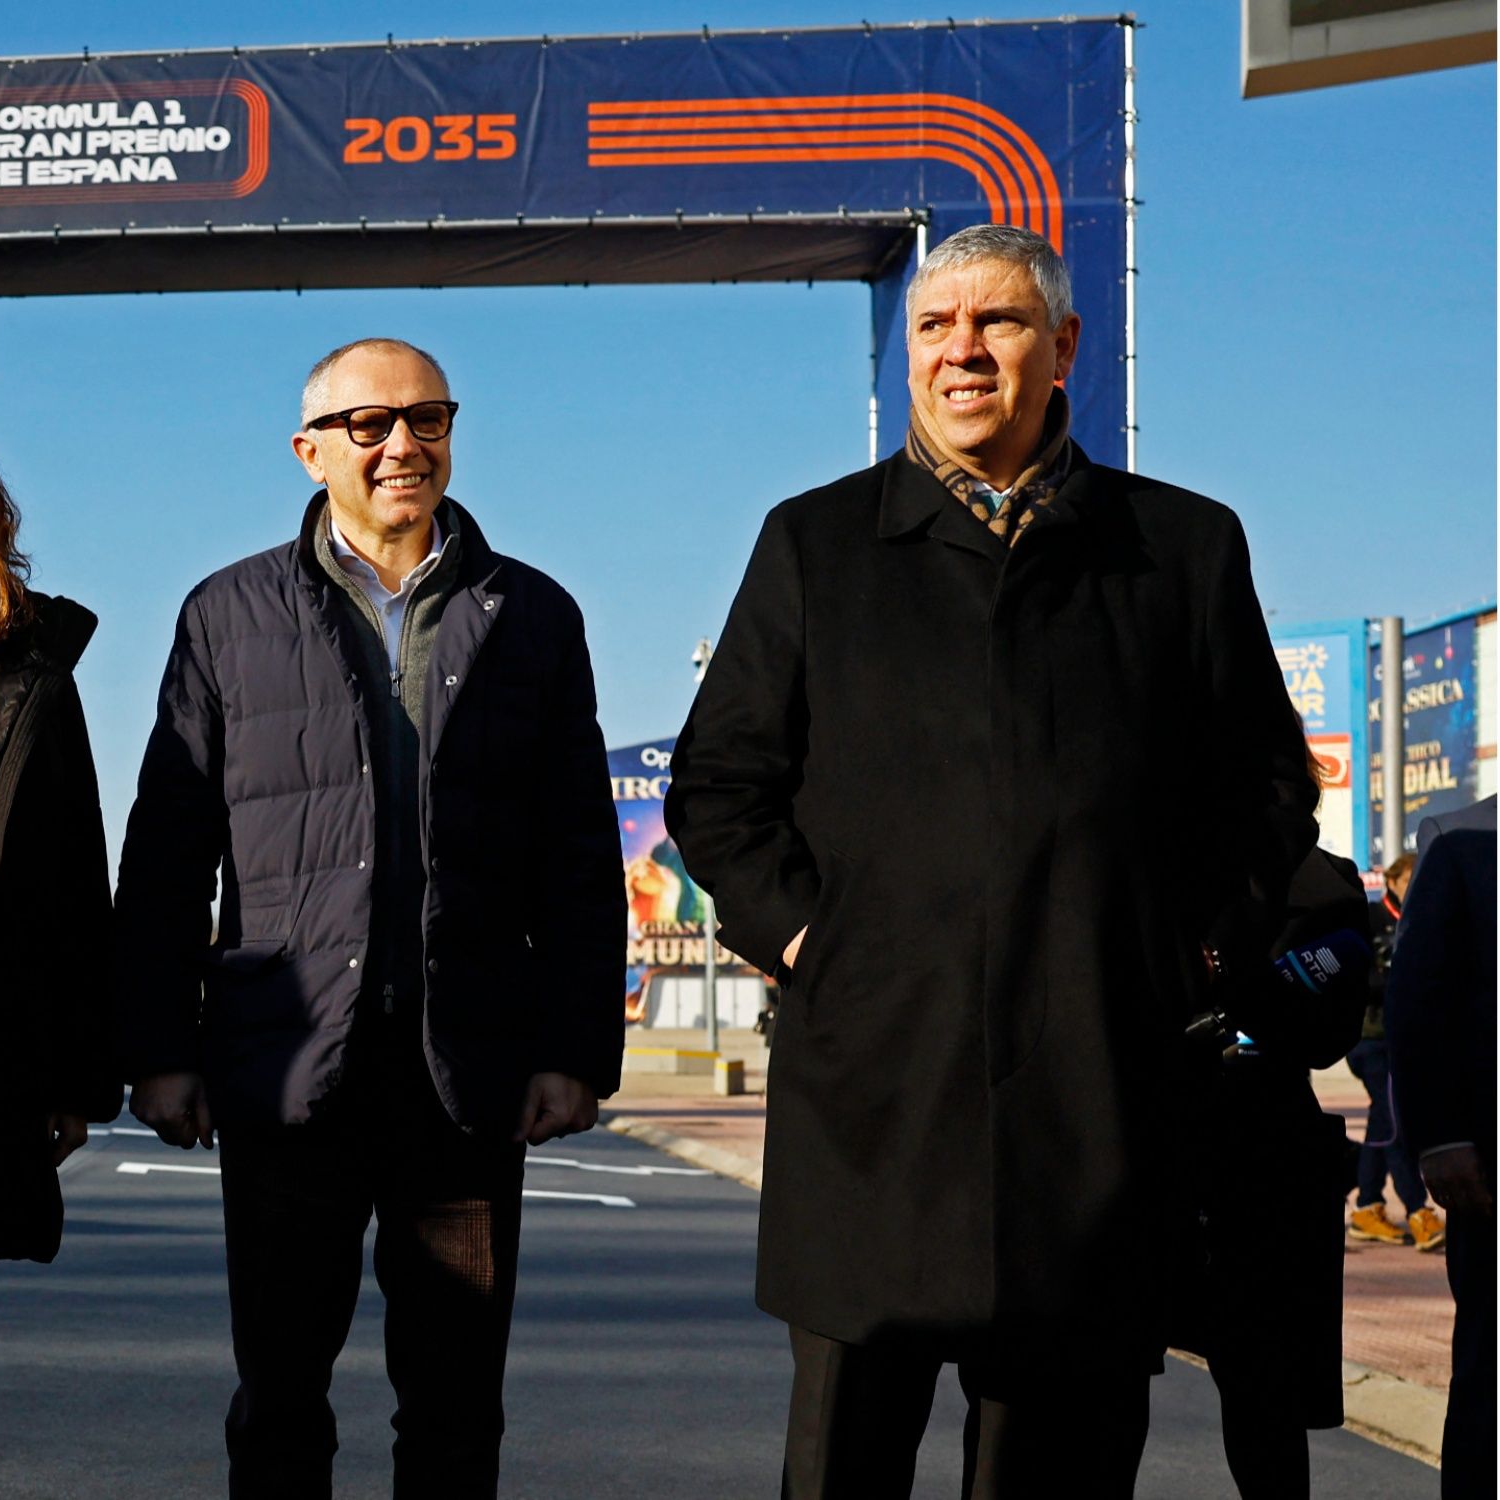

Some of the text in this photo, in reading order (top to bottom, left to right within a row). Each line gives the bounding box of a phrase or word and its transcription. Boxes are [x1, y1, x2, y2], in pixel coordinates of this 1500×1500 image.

[164, 99, 186, 125] 1
[86, 126, 232, 156] PREMIO
[343, 113, 517, 164] 2035
[27, 154, 178, 186] ESPAÑA
[1300, 951, 1328, 984] RTP
